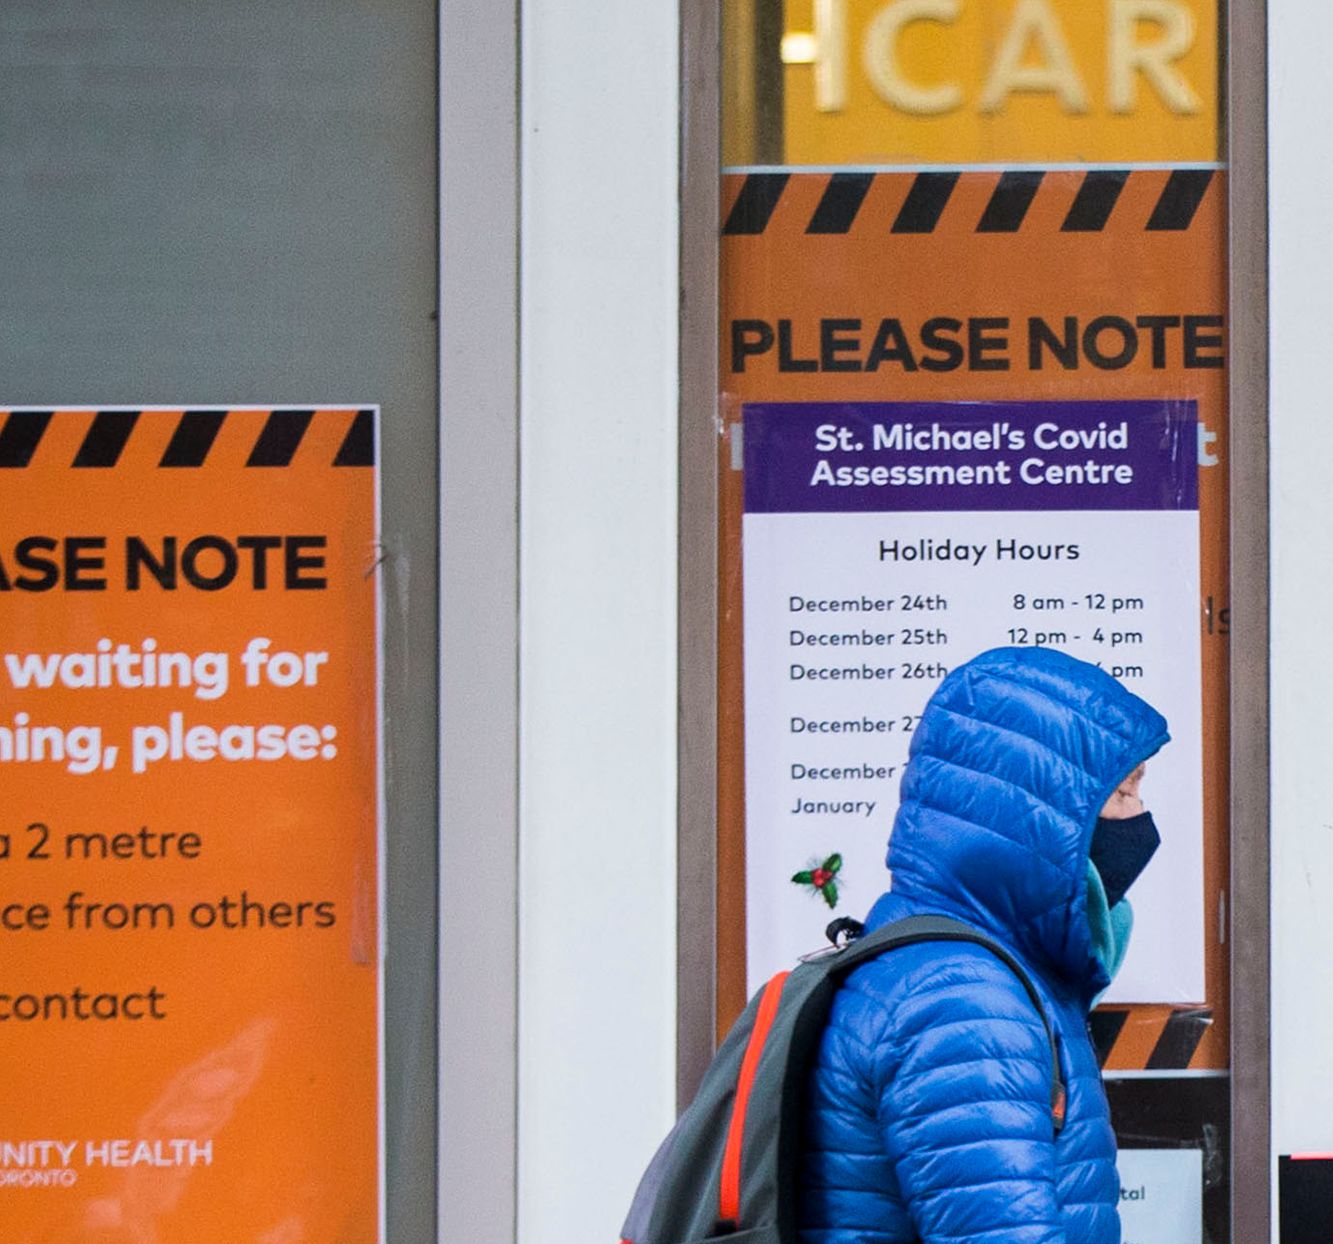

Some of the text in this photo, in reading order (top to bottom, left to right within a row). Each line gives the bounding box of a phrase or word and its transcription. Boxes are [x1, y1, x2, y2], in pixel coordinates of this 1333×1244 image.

[731, 315, 1224, 374] PLEASE NOTE
[816, 422, 1127, 451] St. Michael's Covid
[811, 458, 1132, 486] Assessment Centre
[0, 536, 326, 592] SE NOTE
[880, 539, 1079, 566] Holiday Hours
[789, 595, 947, 612] December 24th
[1013, 594, 1143, 613] 8 am 12 pm
[790, 629, 947, 646] December 25th
[1008, 628, 1143, 648] 12 pm 4 pm
[5, 638, 328, 699] waiting for
[790, 663, 948, 680] December 26th
[1112, 666, 1143, 681] pm
[791, 717, 896, 733] December
[133, 712, 336, 773] please:
[791, 763, 896, 780] December
[791, 798, 875, 817] January
[27, 823, 201, 860] 2 metre
[63, 891, 336, 929] from others
[86, 1139, 212, 1167] HEALTH
